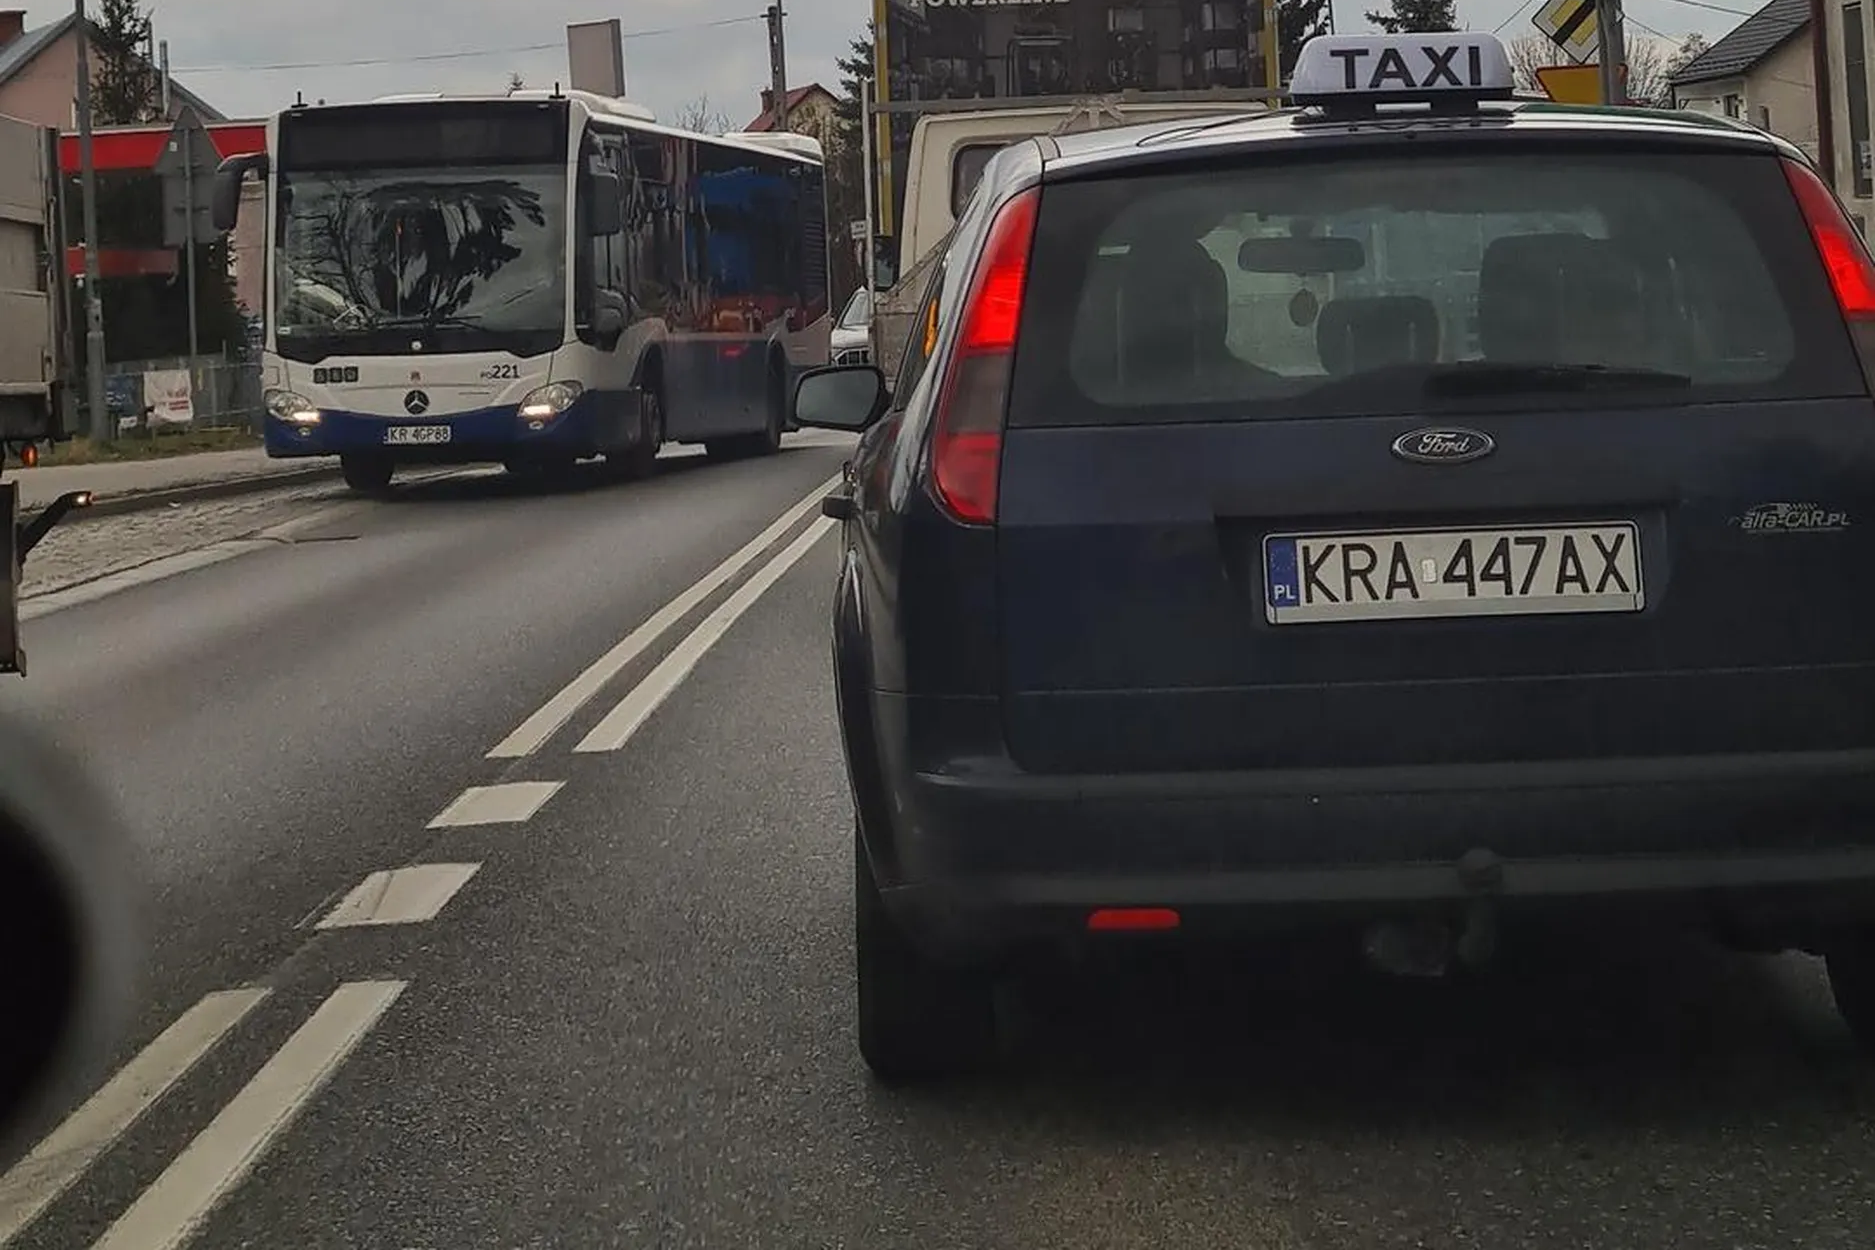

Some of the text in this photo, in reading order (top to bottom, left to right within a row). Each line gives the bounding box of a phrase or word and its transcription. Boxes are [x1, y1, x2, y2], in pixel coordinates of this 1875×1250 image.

[1330, 46, 1481, 89] TAXI
[389, 427, 407, 441] KR
[1418, 433, 1471, 453] Ford
[1302, 533, 1631, 603] KRA 447AX
[1274, 585, 1296, 599] PL
